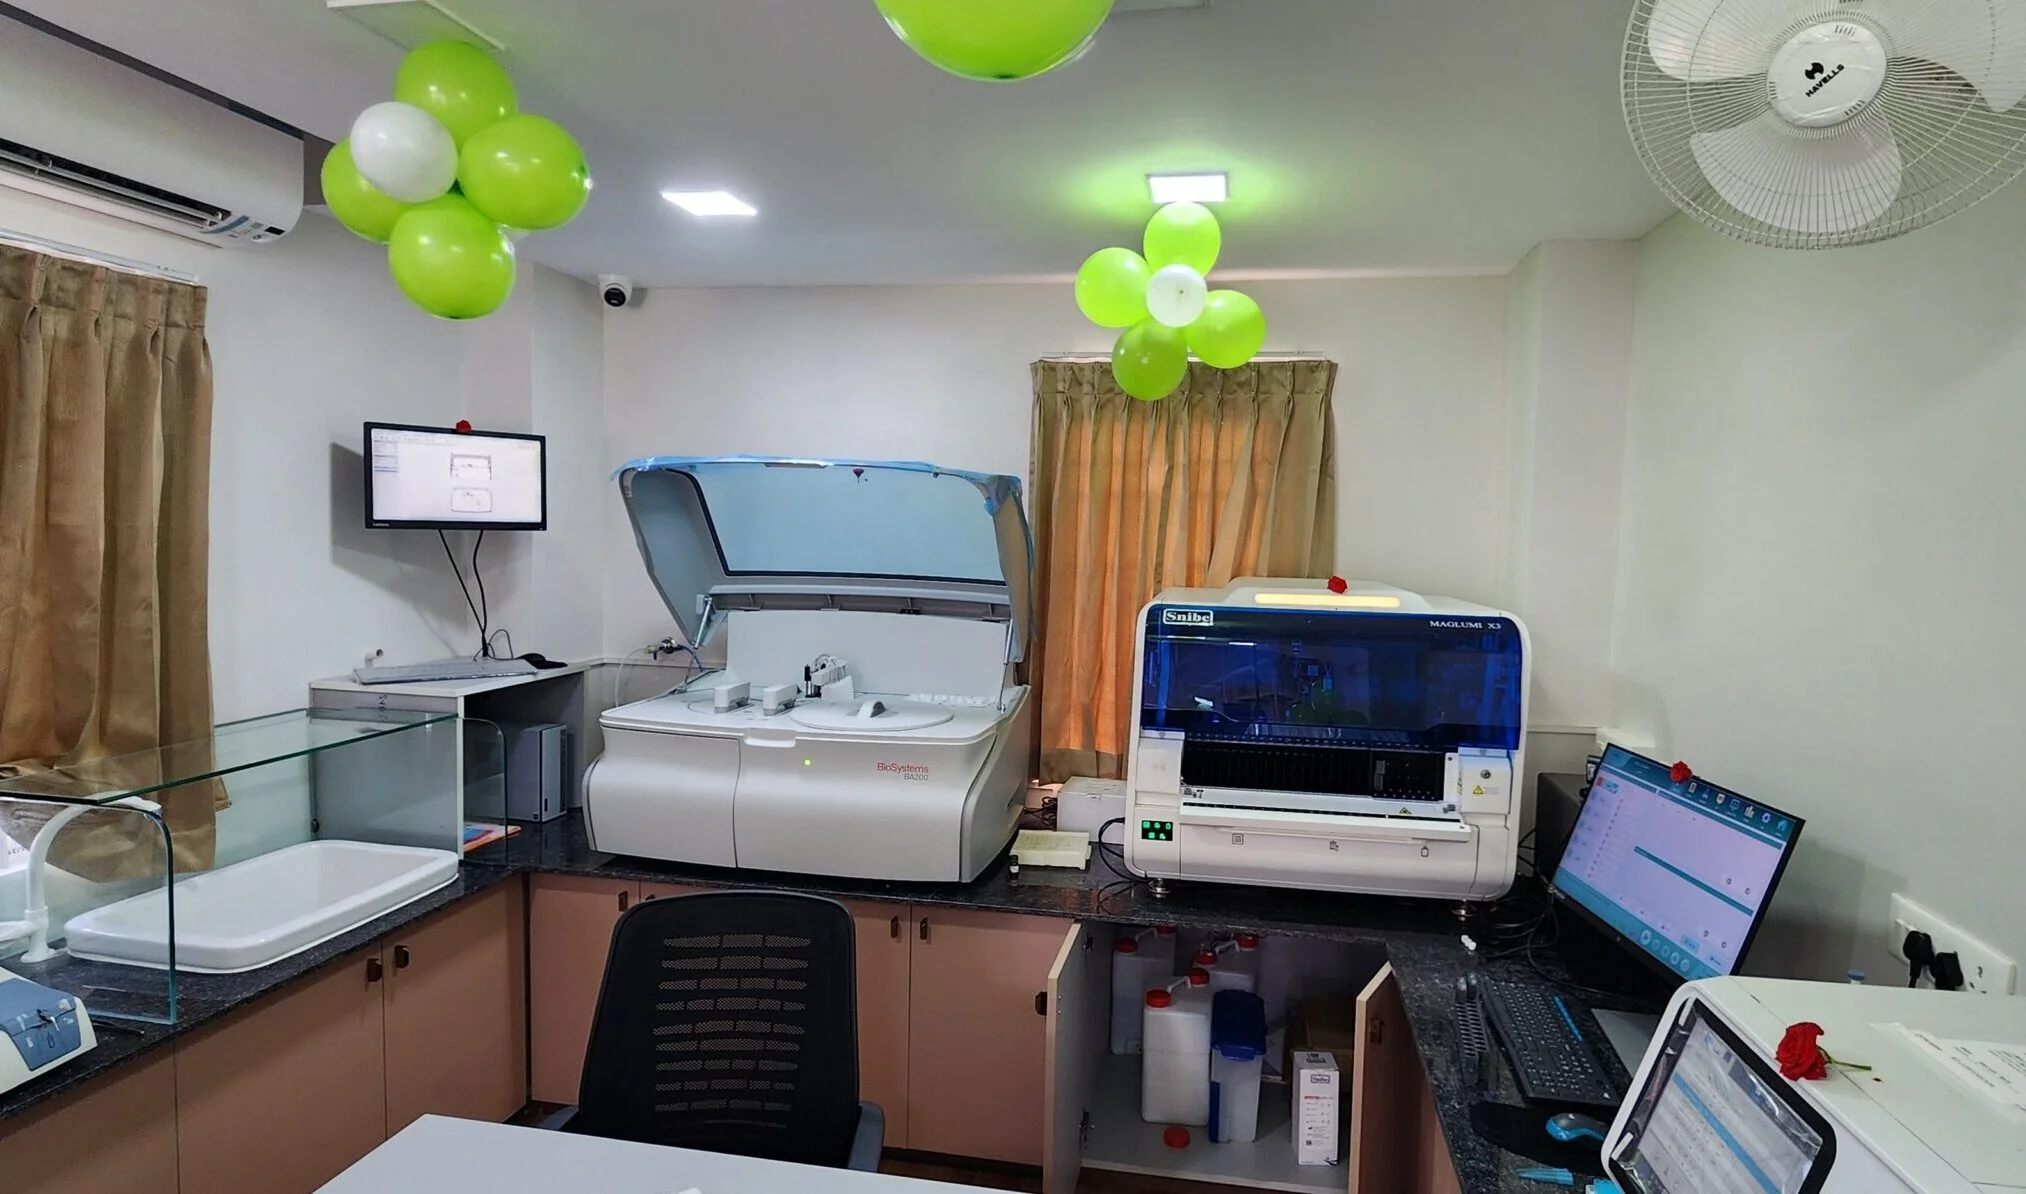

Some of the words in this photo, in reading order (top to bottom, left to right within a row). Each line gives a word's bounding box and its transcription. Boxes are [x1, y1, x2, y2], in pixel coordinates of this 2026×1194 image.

[1805, 64, 1845, 97] HAVELLS
[1166, 611, 1210, 622] Snibe
[1429, 620, 1483, 629] MAGLUMI
[877, 762, 929, 774] BioSystems
[903, 773, 929, 781] BA200
